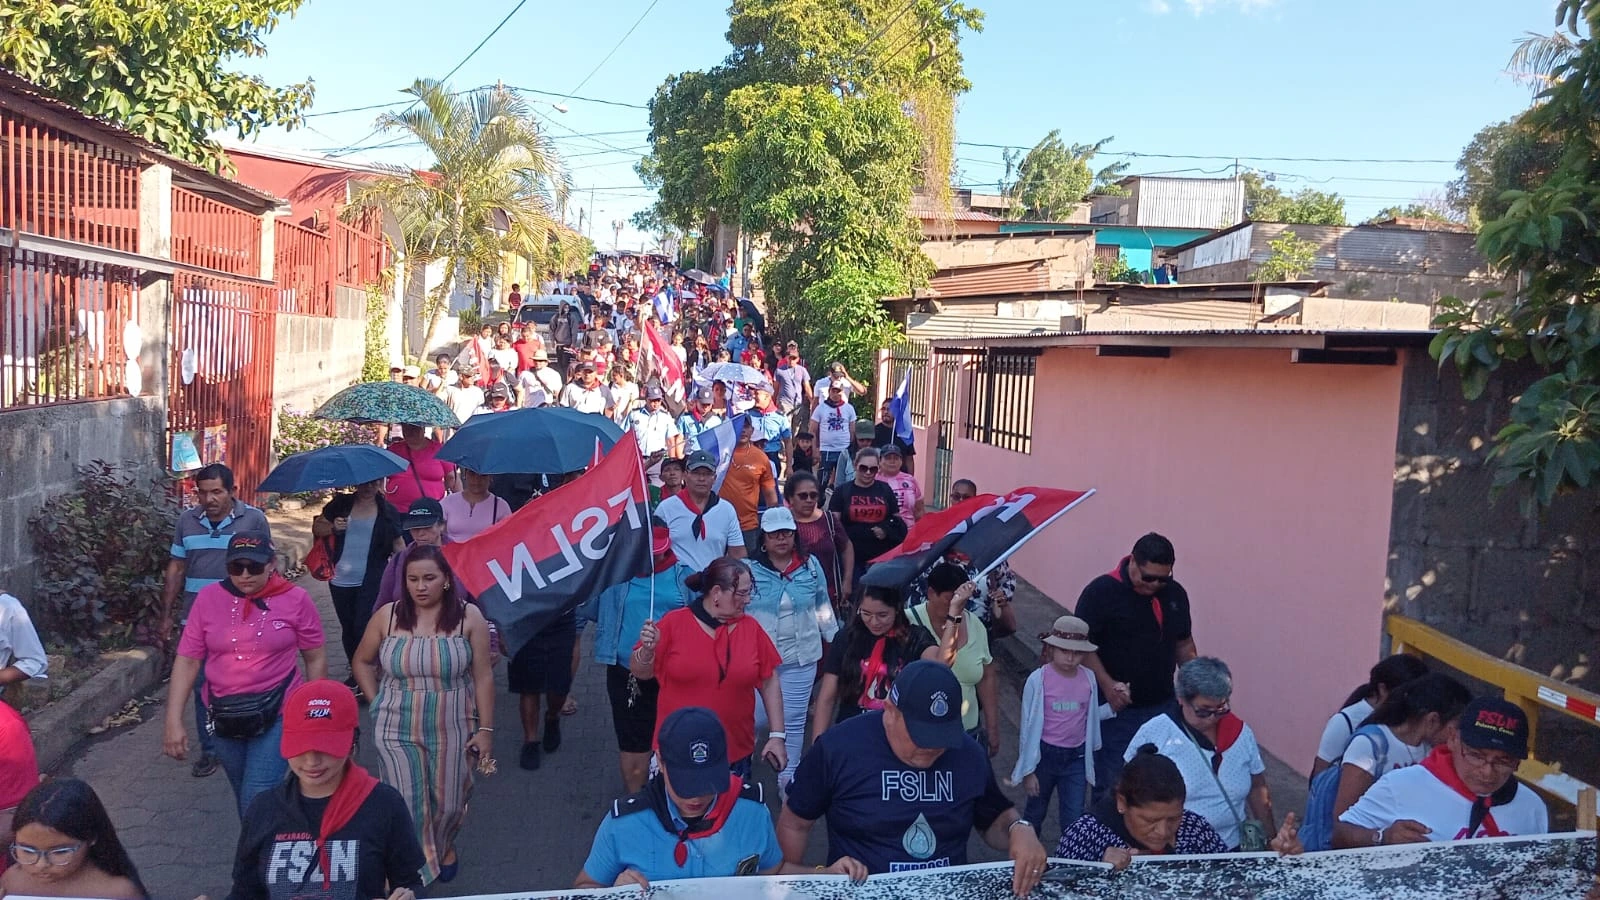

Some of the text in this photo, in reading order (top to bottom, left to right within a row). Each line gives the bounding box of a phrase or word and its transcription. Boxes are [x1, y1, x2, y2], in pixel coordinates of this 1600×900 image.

[1476, 710, 1518, 729] FSLN
[882, 770, 953, 802] FSLN
[275, 831, 313, 841] NICARAGU
